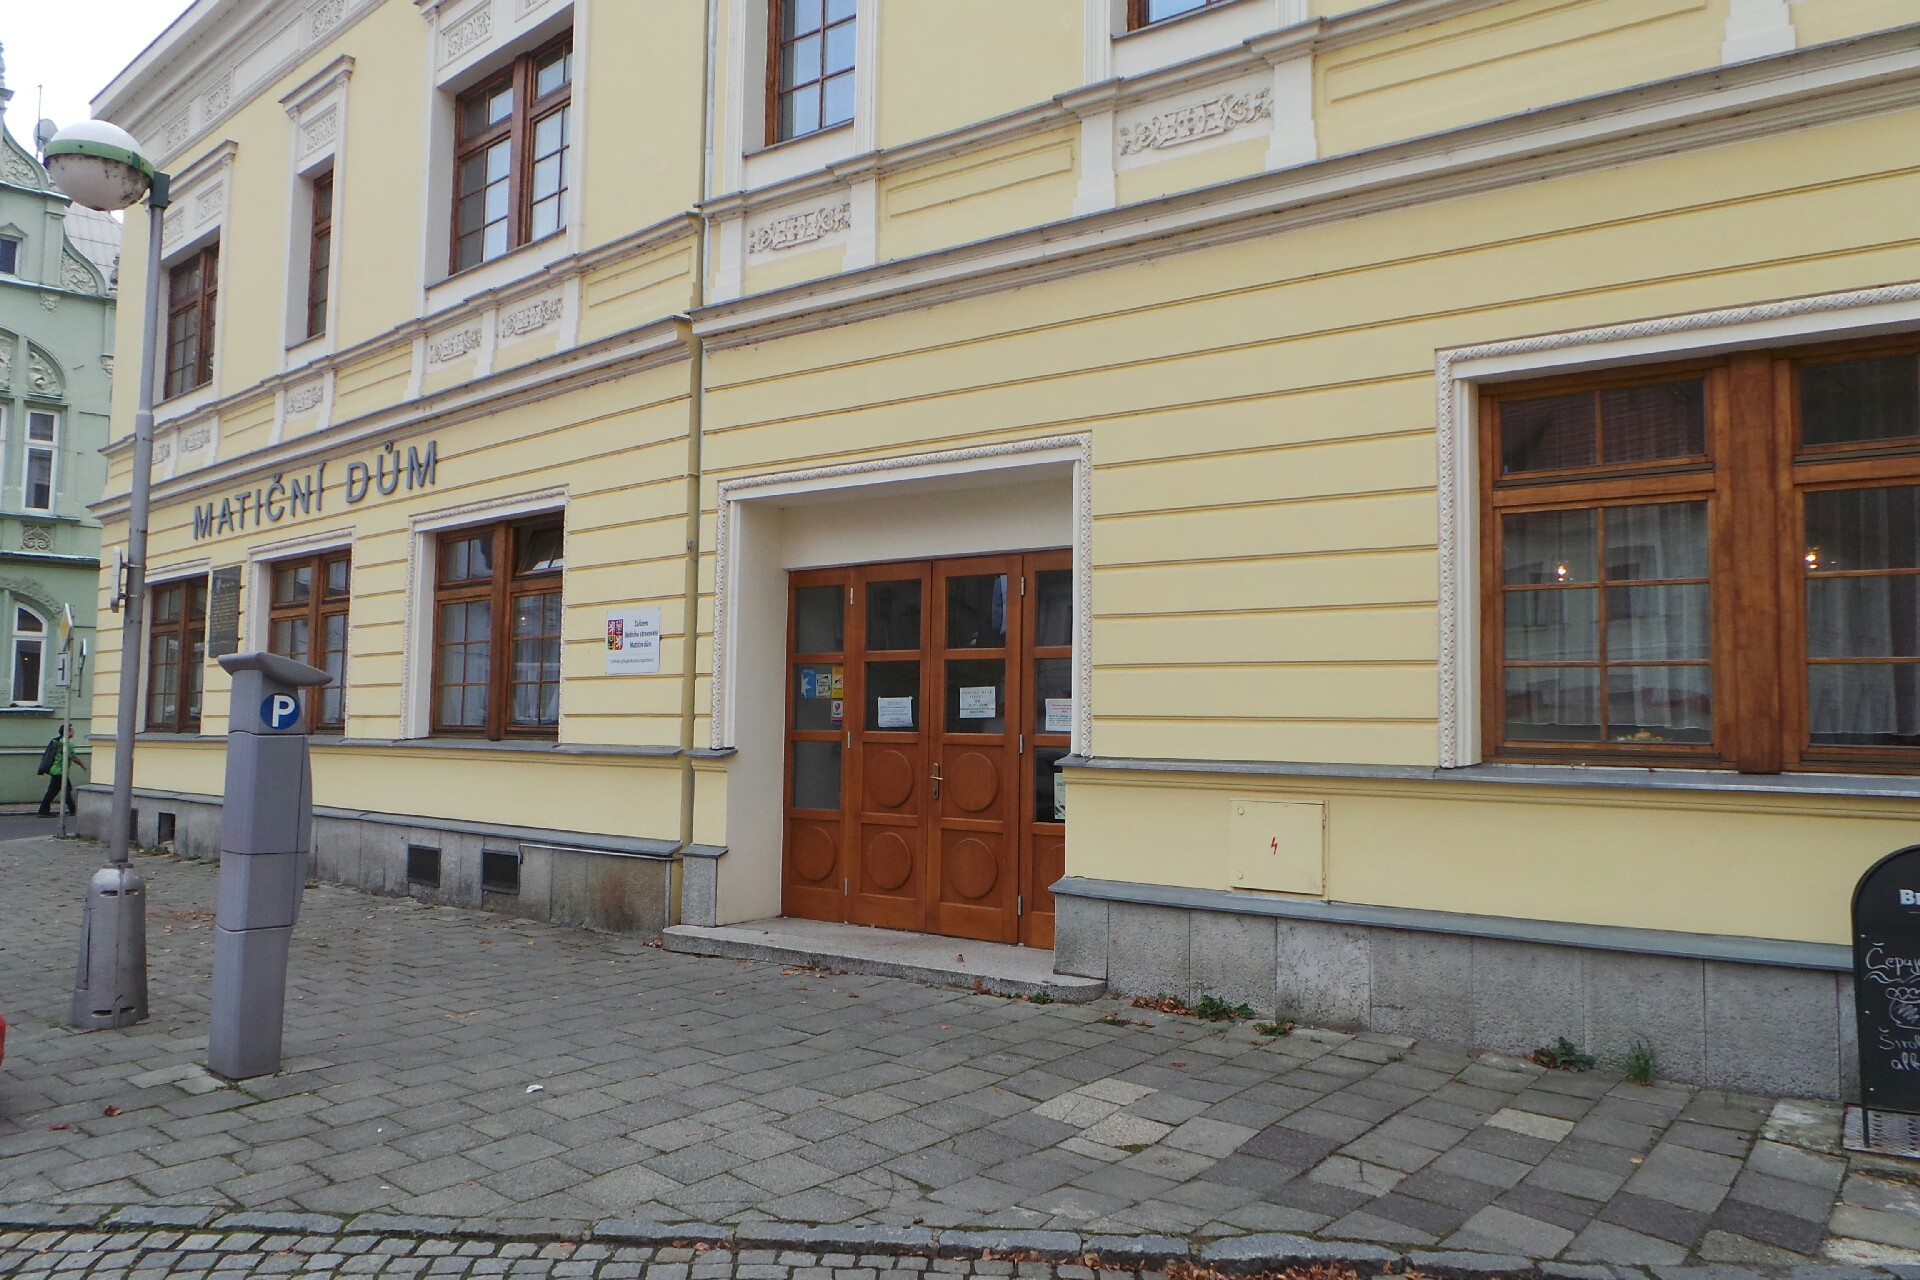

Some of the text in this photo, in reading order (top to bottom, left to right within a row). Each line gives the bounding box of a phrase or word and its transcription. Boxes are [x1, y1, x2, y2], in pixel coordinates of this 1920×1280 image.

[193, 440, 437, 540] MATIČNÍ DŮM
[272, 695, 295, 727] P
